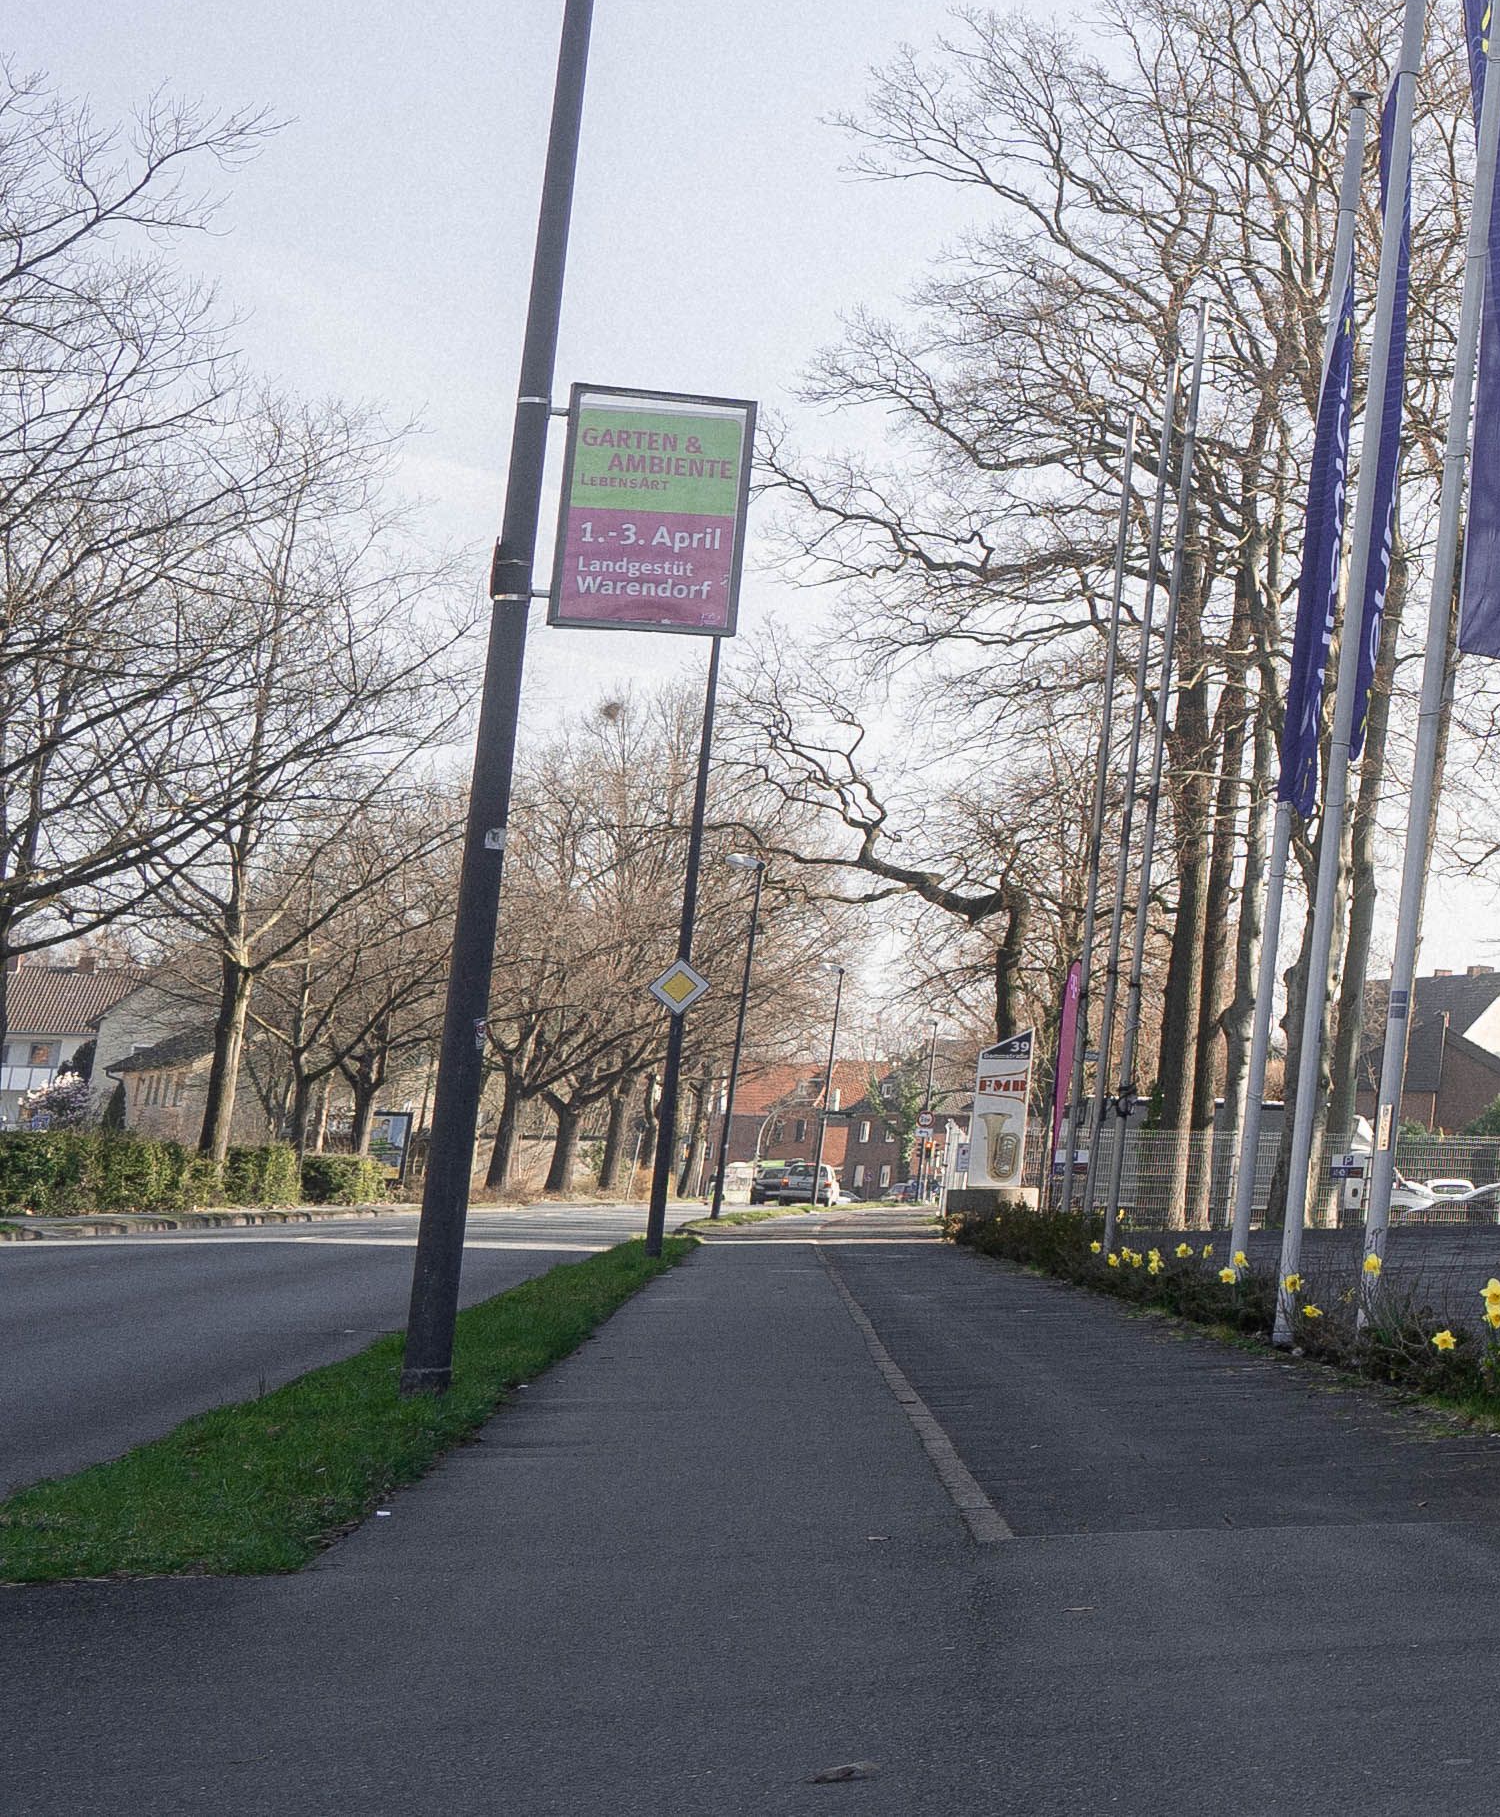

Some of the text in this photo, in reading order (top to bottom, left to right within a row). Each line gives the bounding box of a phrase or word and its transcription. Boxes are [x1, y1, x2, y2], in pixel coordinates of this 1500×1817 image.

[582, 428, 703, 454] GARTEN &
[608, 453, 733, 480] AMBIENTE
[652, 526, 721, 553] April
[578, 556, 694, 578] Landgestüt
[576, 575, 712, 600] Warendorf
[1010, 1041, 1030, 1052] 39
[979, 1079, 1027, 1092] FMB
